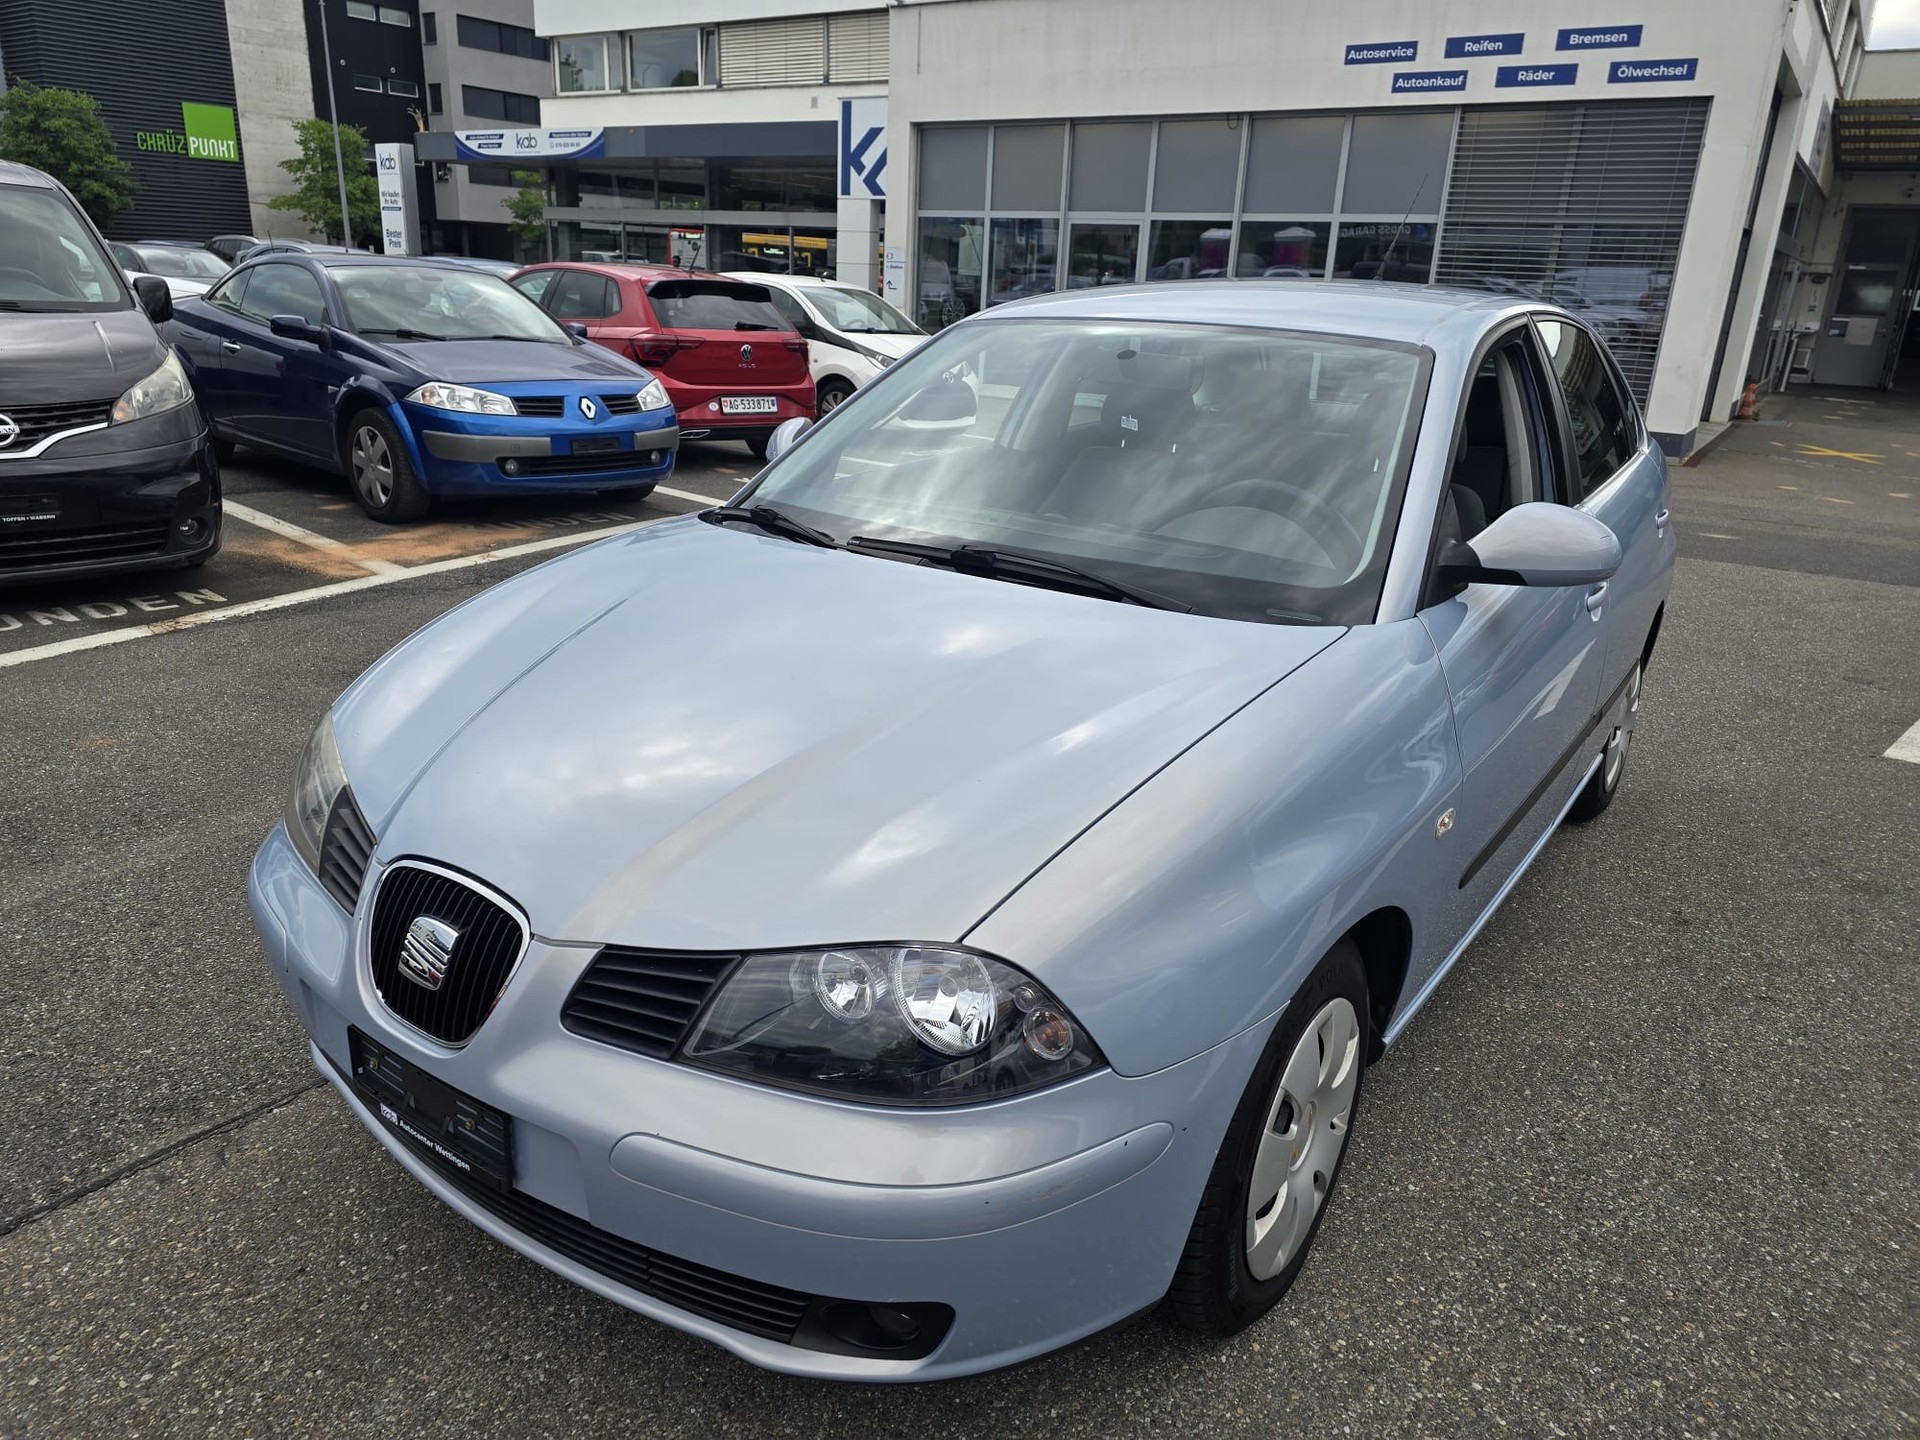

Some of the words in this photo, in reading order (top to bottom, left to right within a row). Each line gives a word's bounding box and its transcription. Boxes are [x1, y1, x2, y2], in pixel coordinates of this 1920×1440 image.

[1569, 31, 1628, 45] Bremsen
[1464, 40, 1503, 52] Reifen
[1348, 47, 1414, 61] Autoservice
[1517, 70, 1555, 82] Räder
[1617, 64, 1688, 78] Ölwechsel
[1396, 75, 1464, 89] Autoankauf
[136, 128, 187, 154] CHRÜZ
[189, 137, 235, 158] PUNKT
[400, 1120, 433, 1148] Autocenter
[434, 1143, 471, 1171] Wettingen
